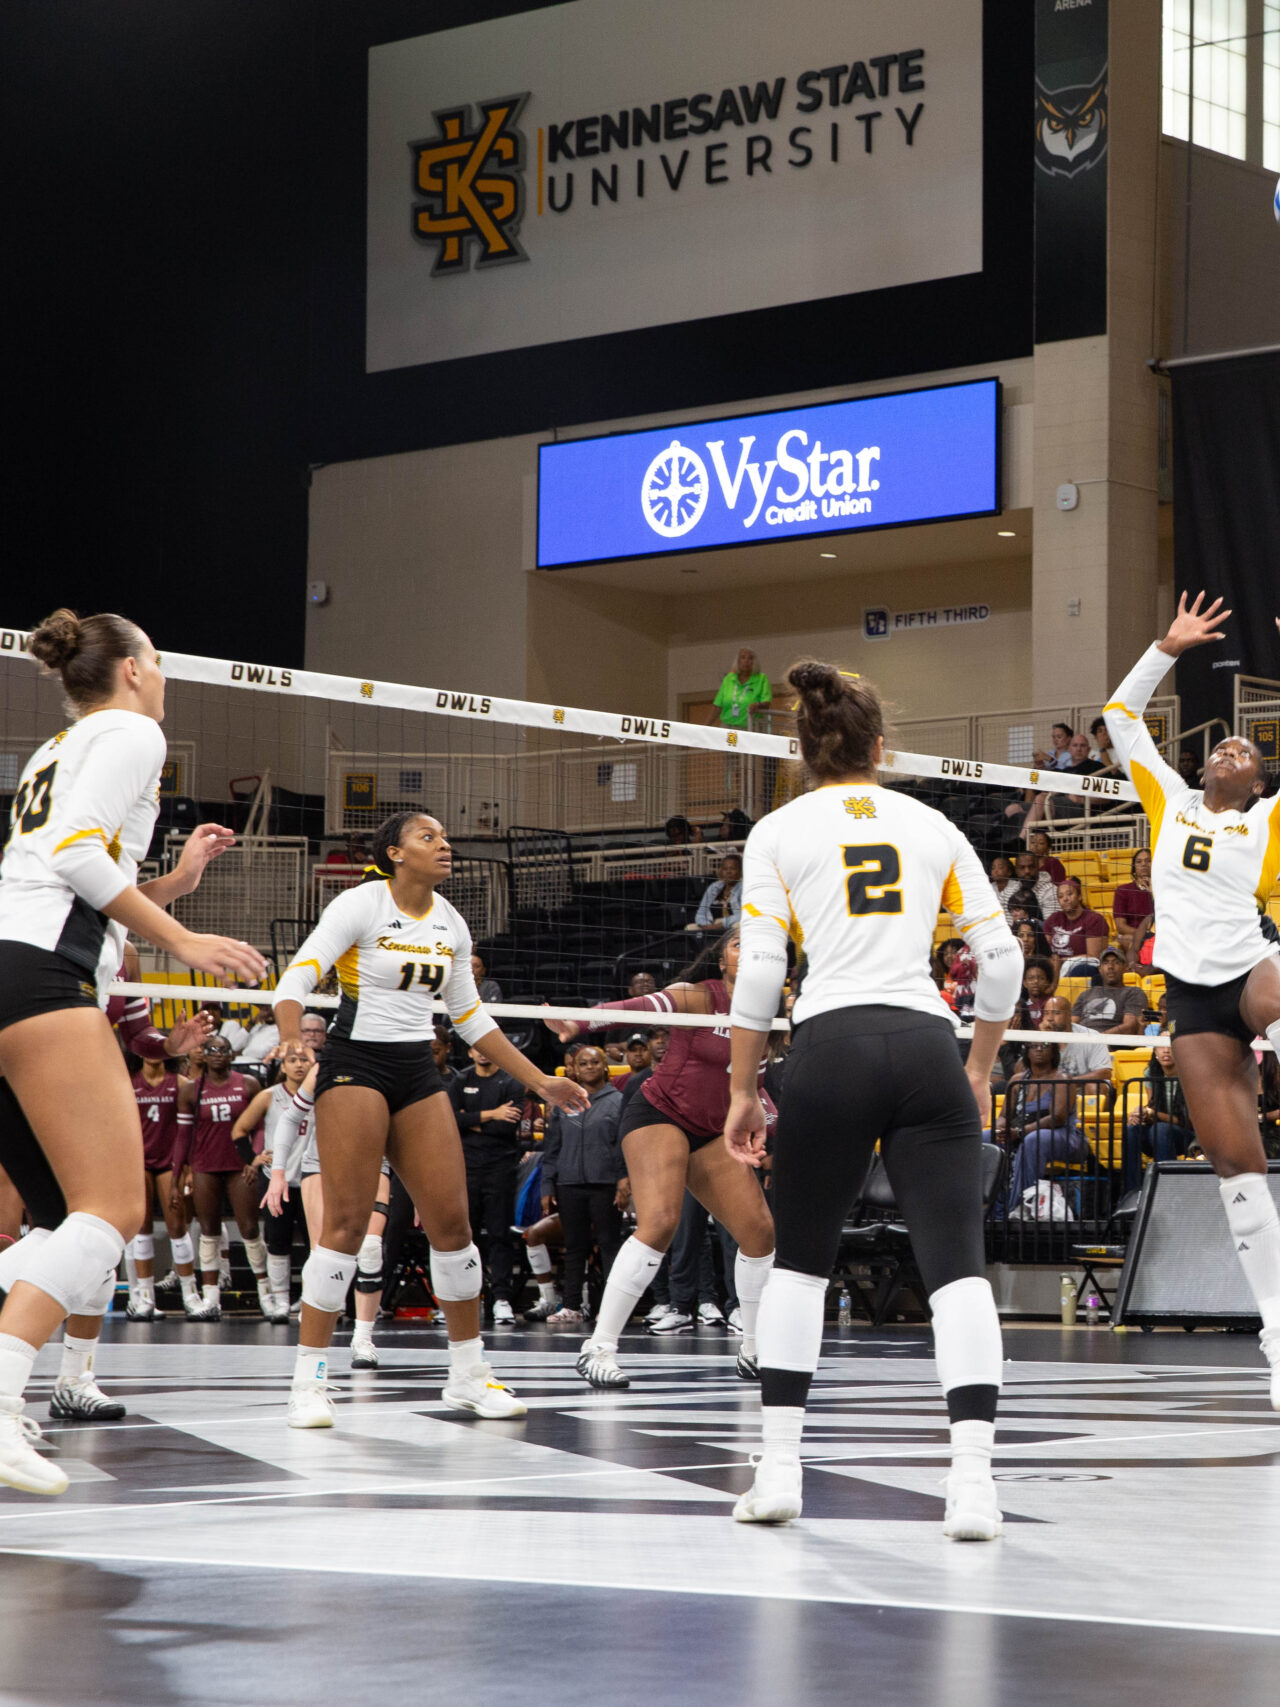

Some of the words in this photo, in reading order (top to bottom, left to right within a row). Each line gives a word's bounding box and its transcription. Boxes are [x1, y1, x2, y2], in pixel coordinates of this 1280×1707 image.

[547, 77, 786, 164] KENNESAW
[797, 48, 925, 113] STATE
[548, 102, 924, 213] UNIVERSITY
[765, 500, 817, 525] Credit
[821, 495, 872, 518] Union
[895, 611, 937, 628] FIFTH
[943, 605, 989, 622] THIRD
[231, 664, 292, 687] OWLS
[436, 692, 491, 714] OWLS
[621, 717, 671, 738] OWLS
[942, 759, 983, 777] OWLS
[1082, 777, 1120, 794] OWLS
[1182, 834, 1213, 873] 6
[839, 842, 904, 918] 2
[398, 961, 445, 993] 14
[147, 1104, 160, 1122] 4
[210, 1103, 231, 1122] 12
